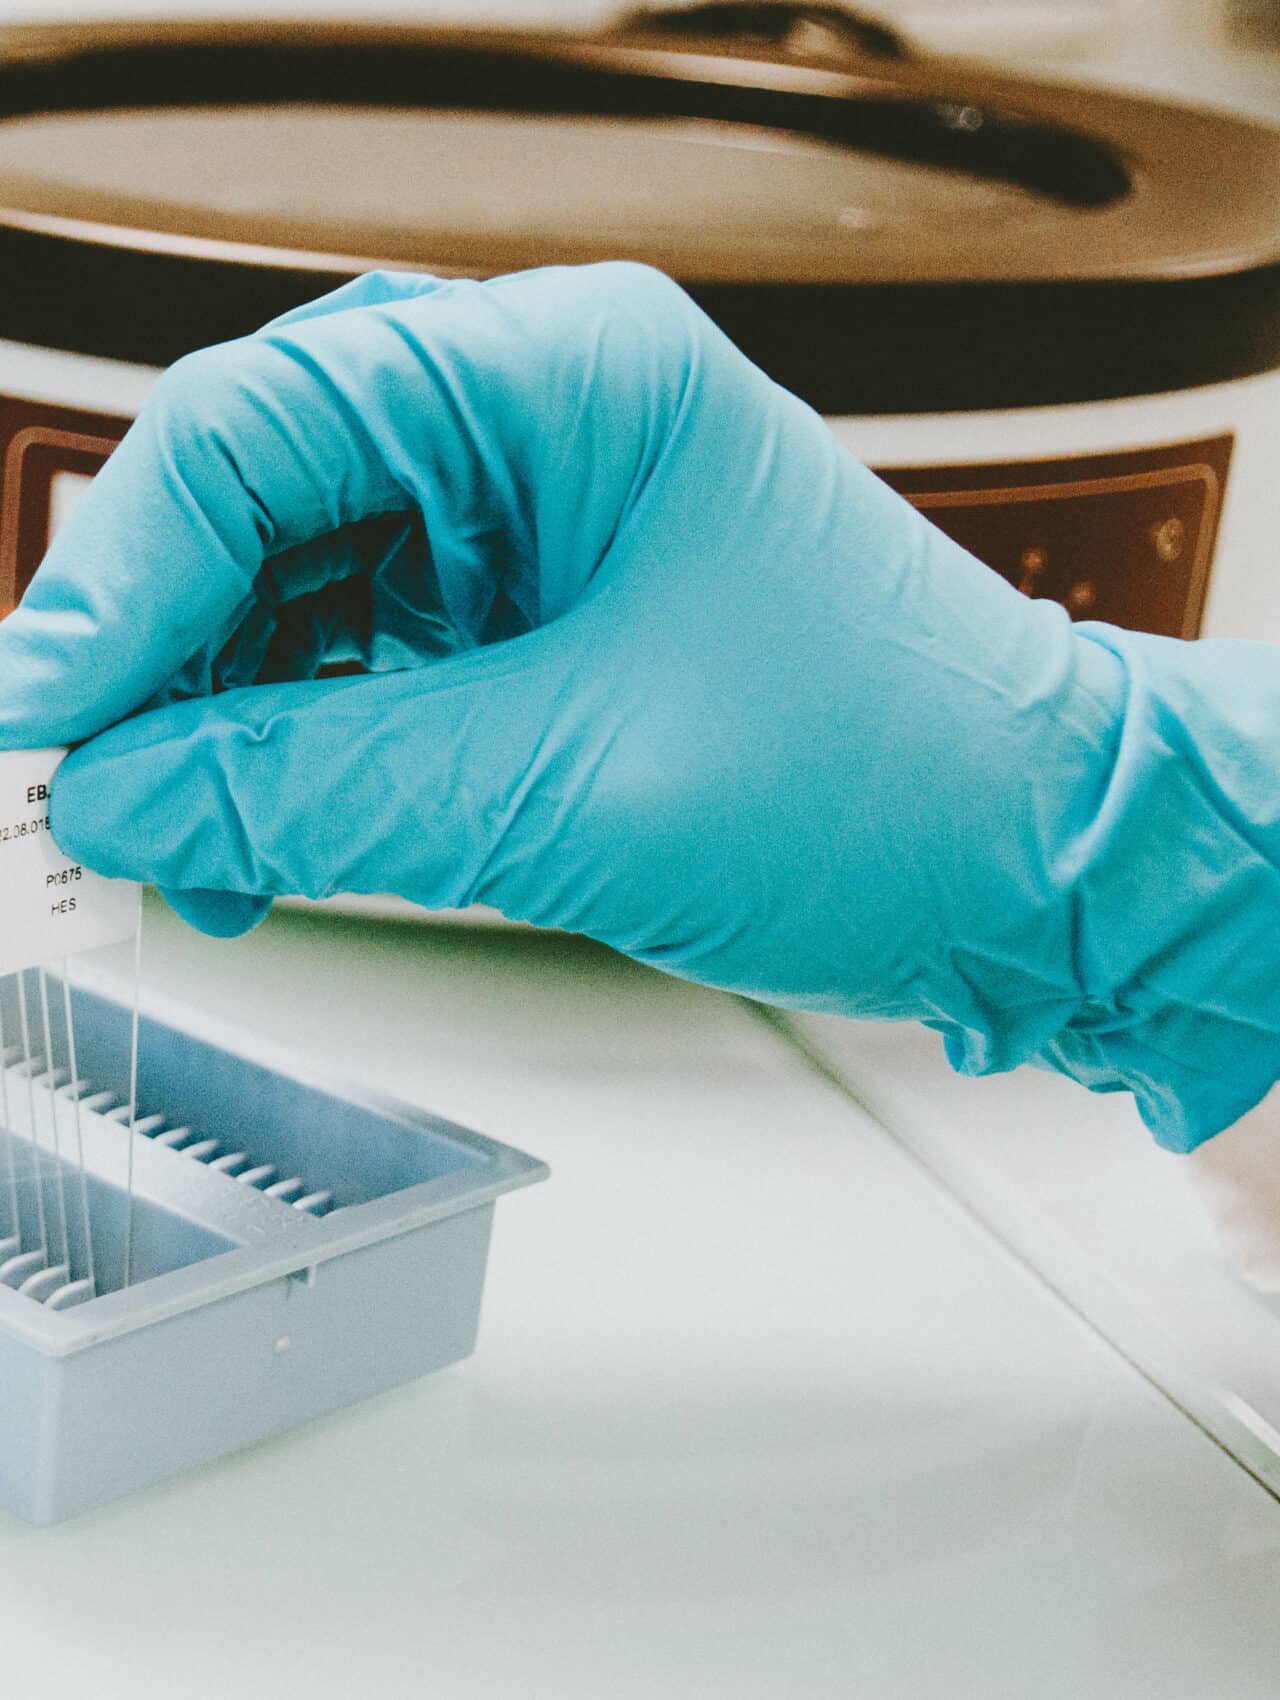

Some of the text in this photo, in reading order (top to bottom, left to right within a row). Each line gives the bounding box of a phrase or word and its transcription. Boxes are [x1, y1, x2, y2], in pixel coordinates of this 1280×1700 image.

[27, 784, 51, 803] EB.
[46, 866, 82, 888] P0675
[51, 897, 77, 917] HES
